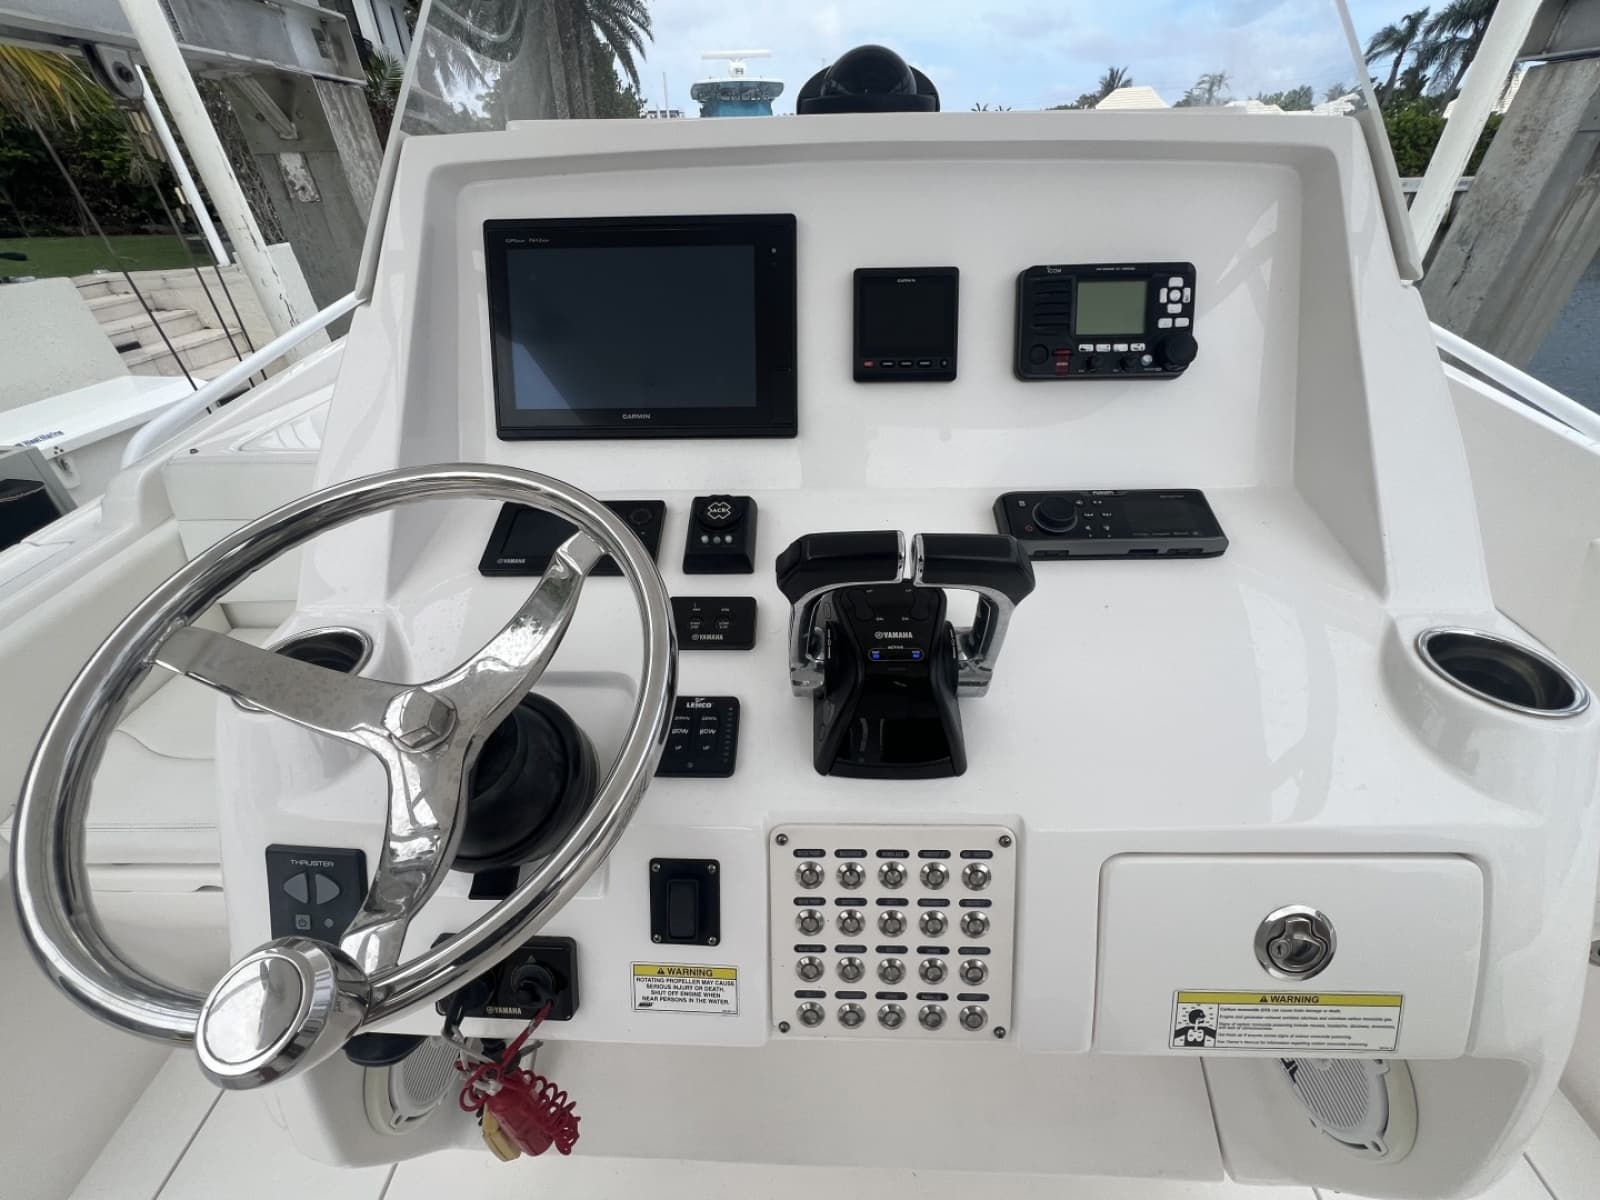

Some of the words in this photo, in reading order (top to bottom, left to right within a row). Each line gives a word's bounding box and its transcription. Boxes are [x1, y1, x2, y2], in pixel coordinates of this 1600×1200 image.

[883, 631, 913, 639] YAMAHA
[290, 859, 335, 868] THRUSTER
[667, 967, 713, 977] WARNING
[1270, 995, 1320, 1004] WARNING
[494, 1007, 522, 1015] YAMAHA
